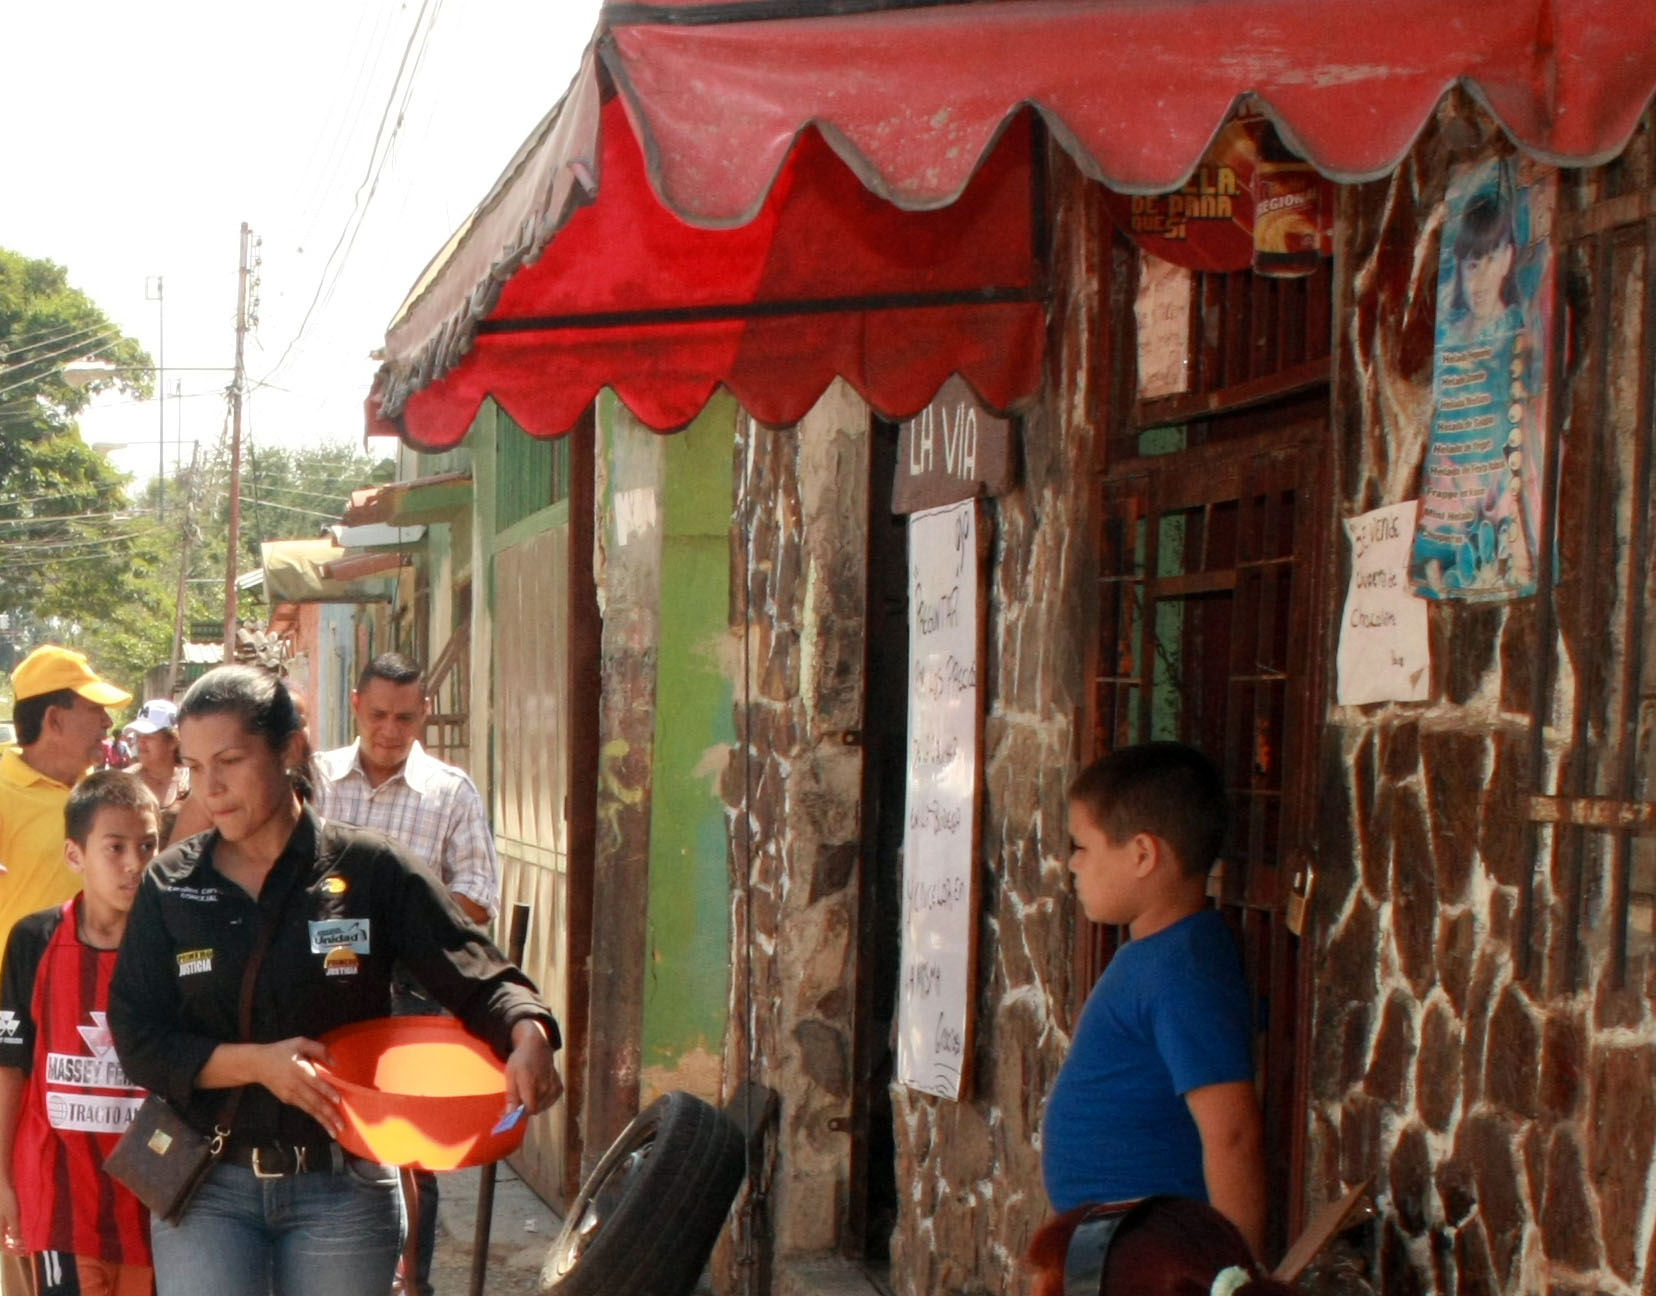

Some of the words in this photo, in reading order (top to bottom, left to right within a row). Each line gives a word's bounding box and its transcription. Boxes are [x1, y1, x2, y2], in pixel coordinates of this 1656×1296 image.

[910, 403, 933, 476] LA
[178, 958, 212, 977] JUSTICIA
[48, 1056, 102, 1084] MASSEY
[69, 1103, 121, 1125] TRACTO
